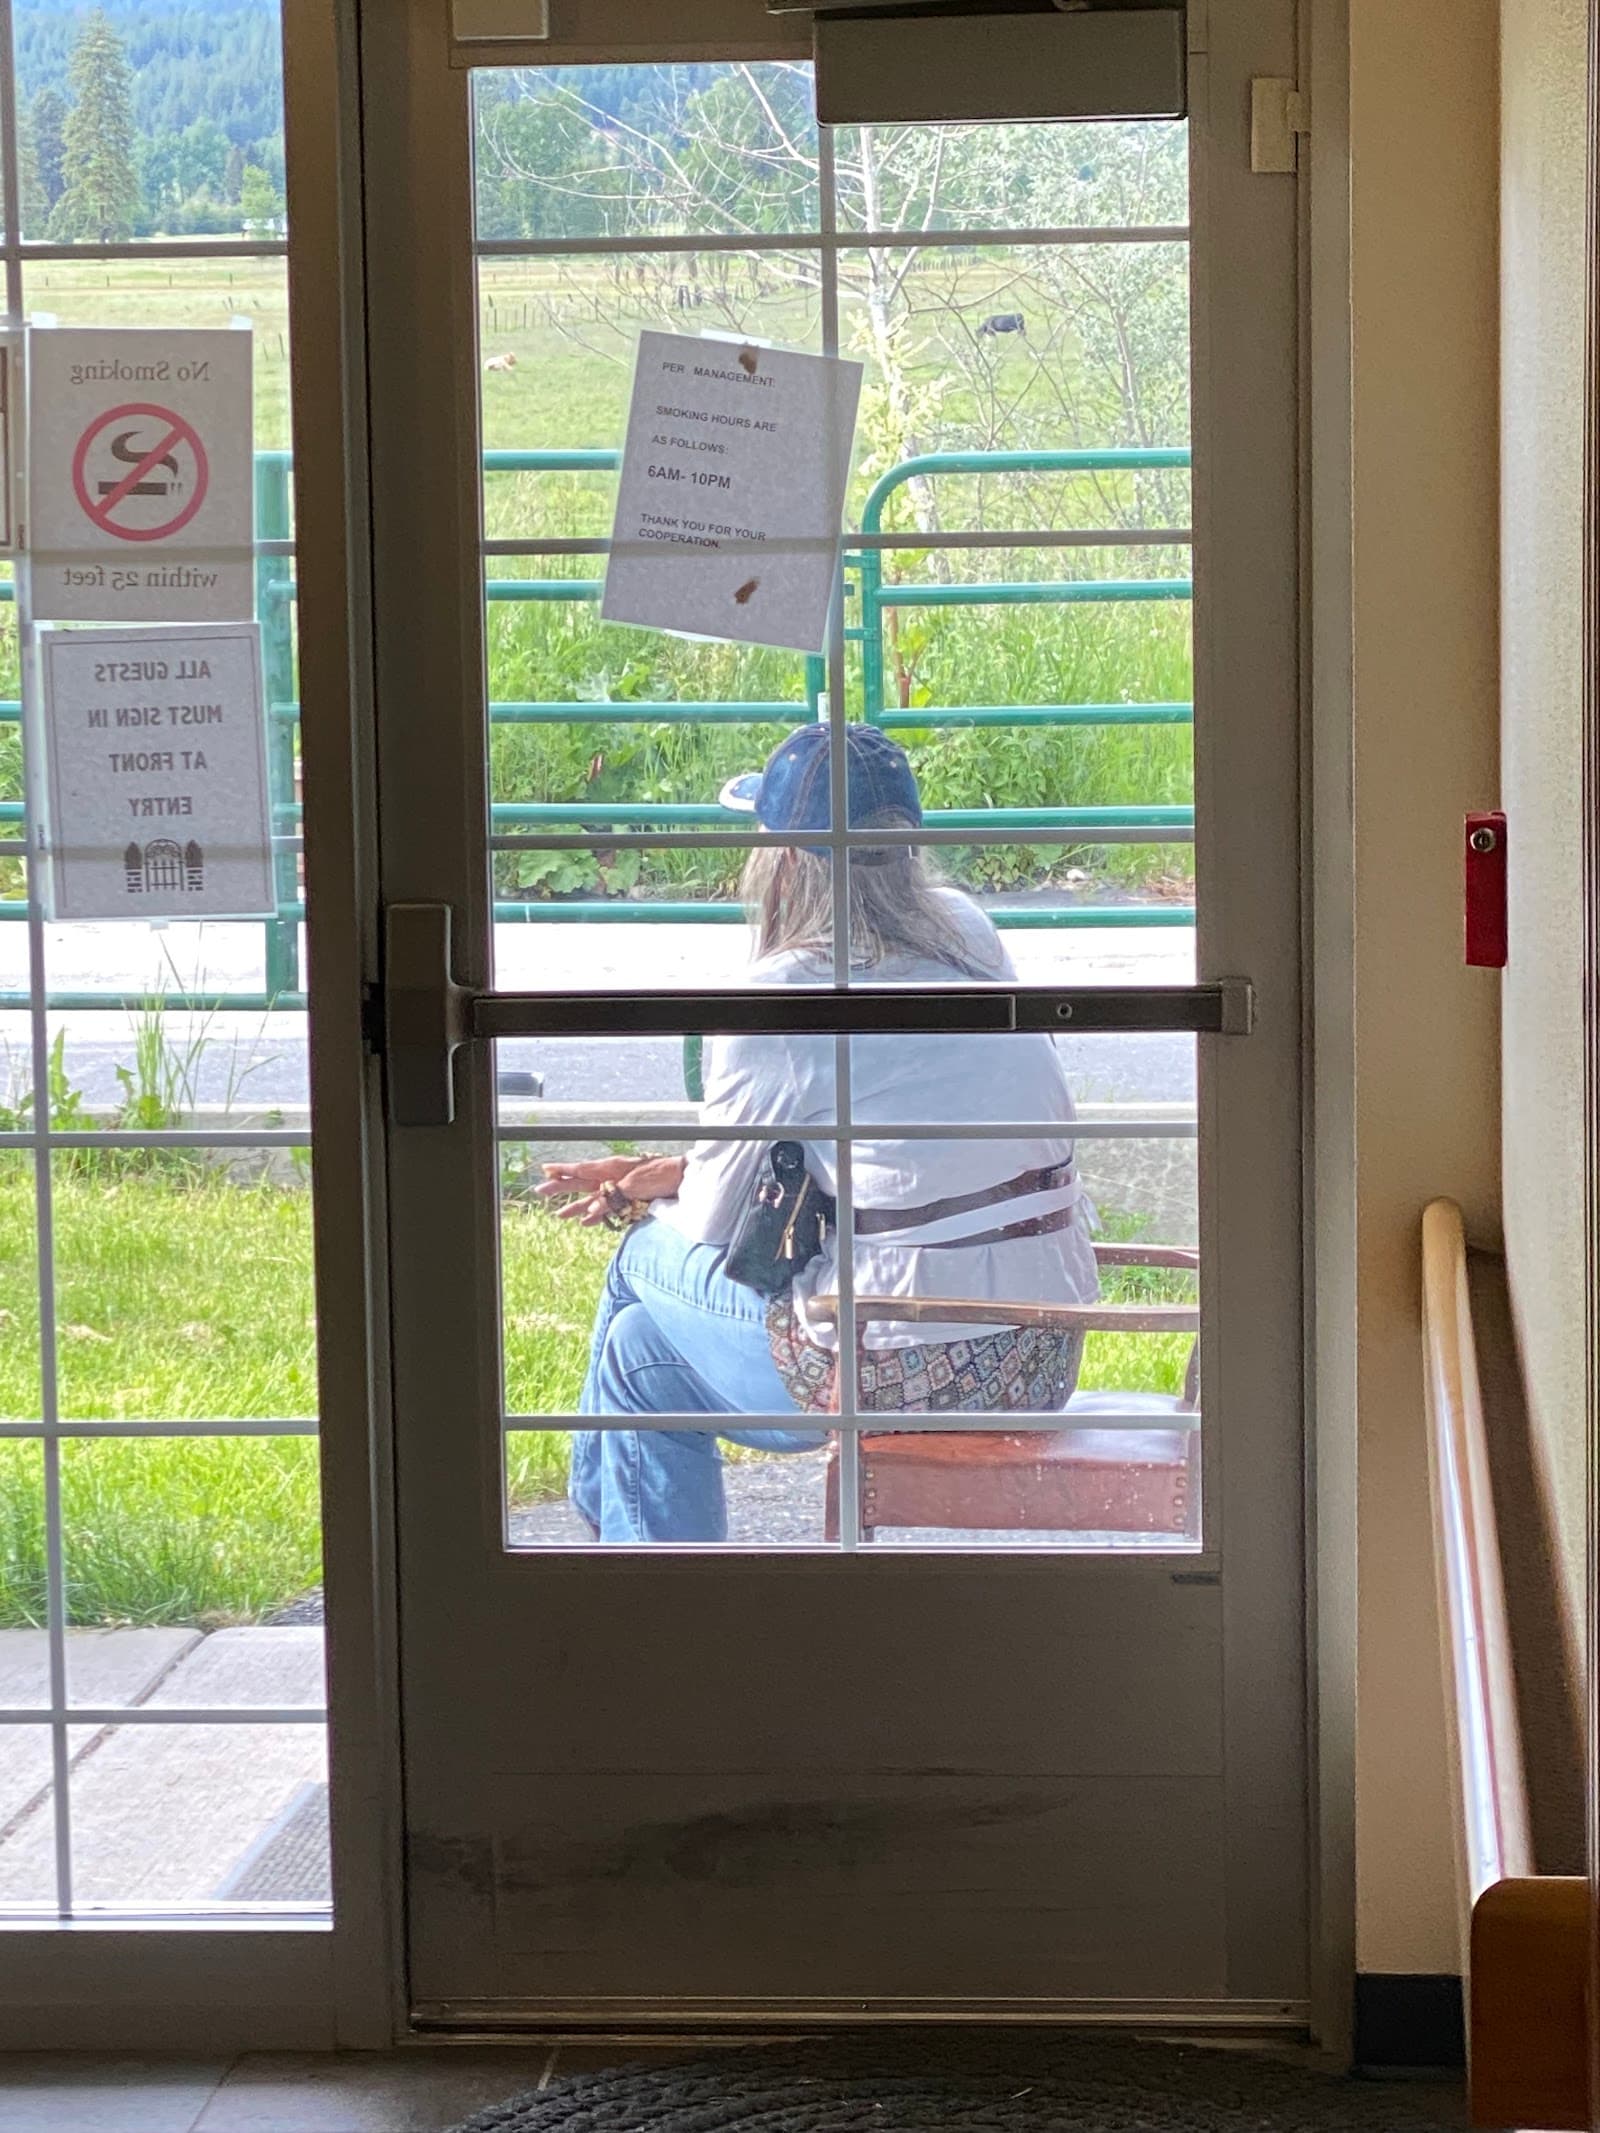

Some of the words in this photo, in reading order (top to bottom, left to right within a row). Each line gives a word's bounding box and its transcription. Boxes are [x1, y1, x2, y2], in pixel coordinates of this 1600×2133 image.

[662, 361, 685, 374] PER
[656, 405, 708, 422] SMOKING
[711, 414, 751, 428] HOURS
[753, 421, 777, 432] ARE
[651, 434, 667, 445] AS
[670, 437, 729, 454] FOLLOWS:
[691, 472, 731, 489] 10PM
[641, 513, 679, 527] THANK
[682, 520, 705, 532] YOU
[708, 523, 732, 536] FOR
[735, 527, 766, 541] YOUR
[639, 528, 721, 549] COOPERATION.
